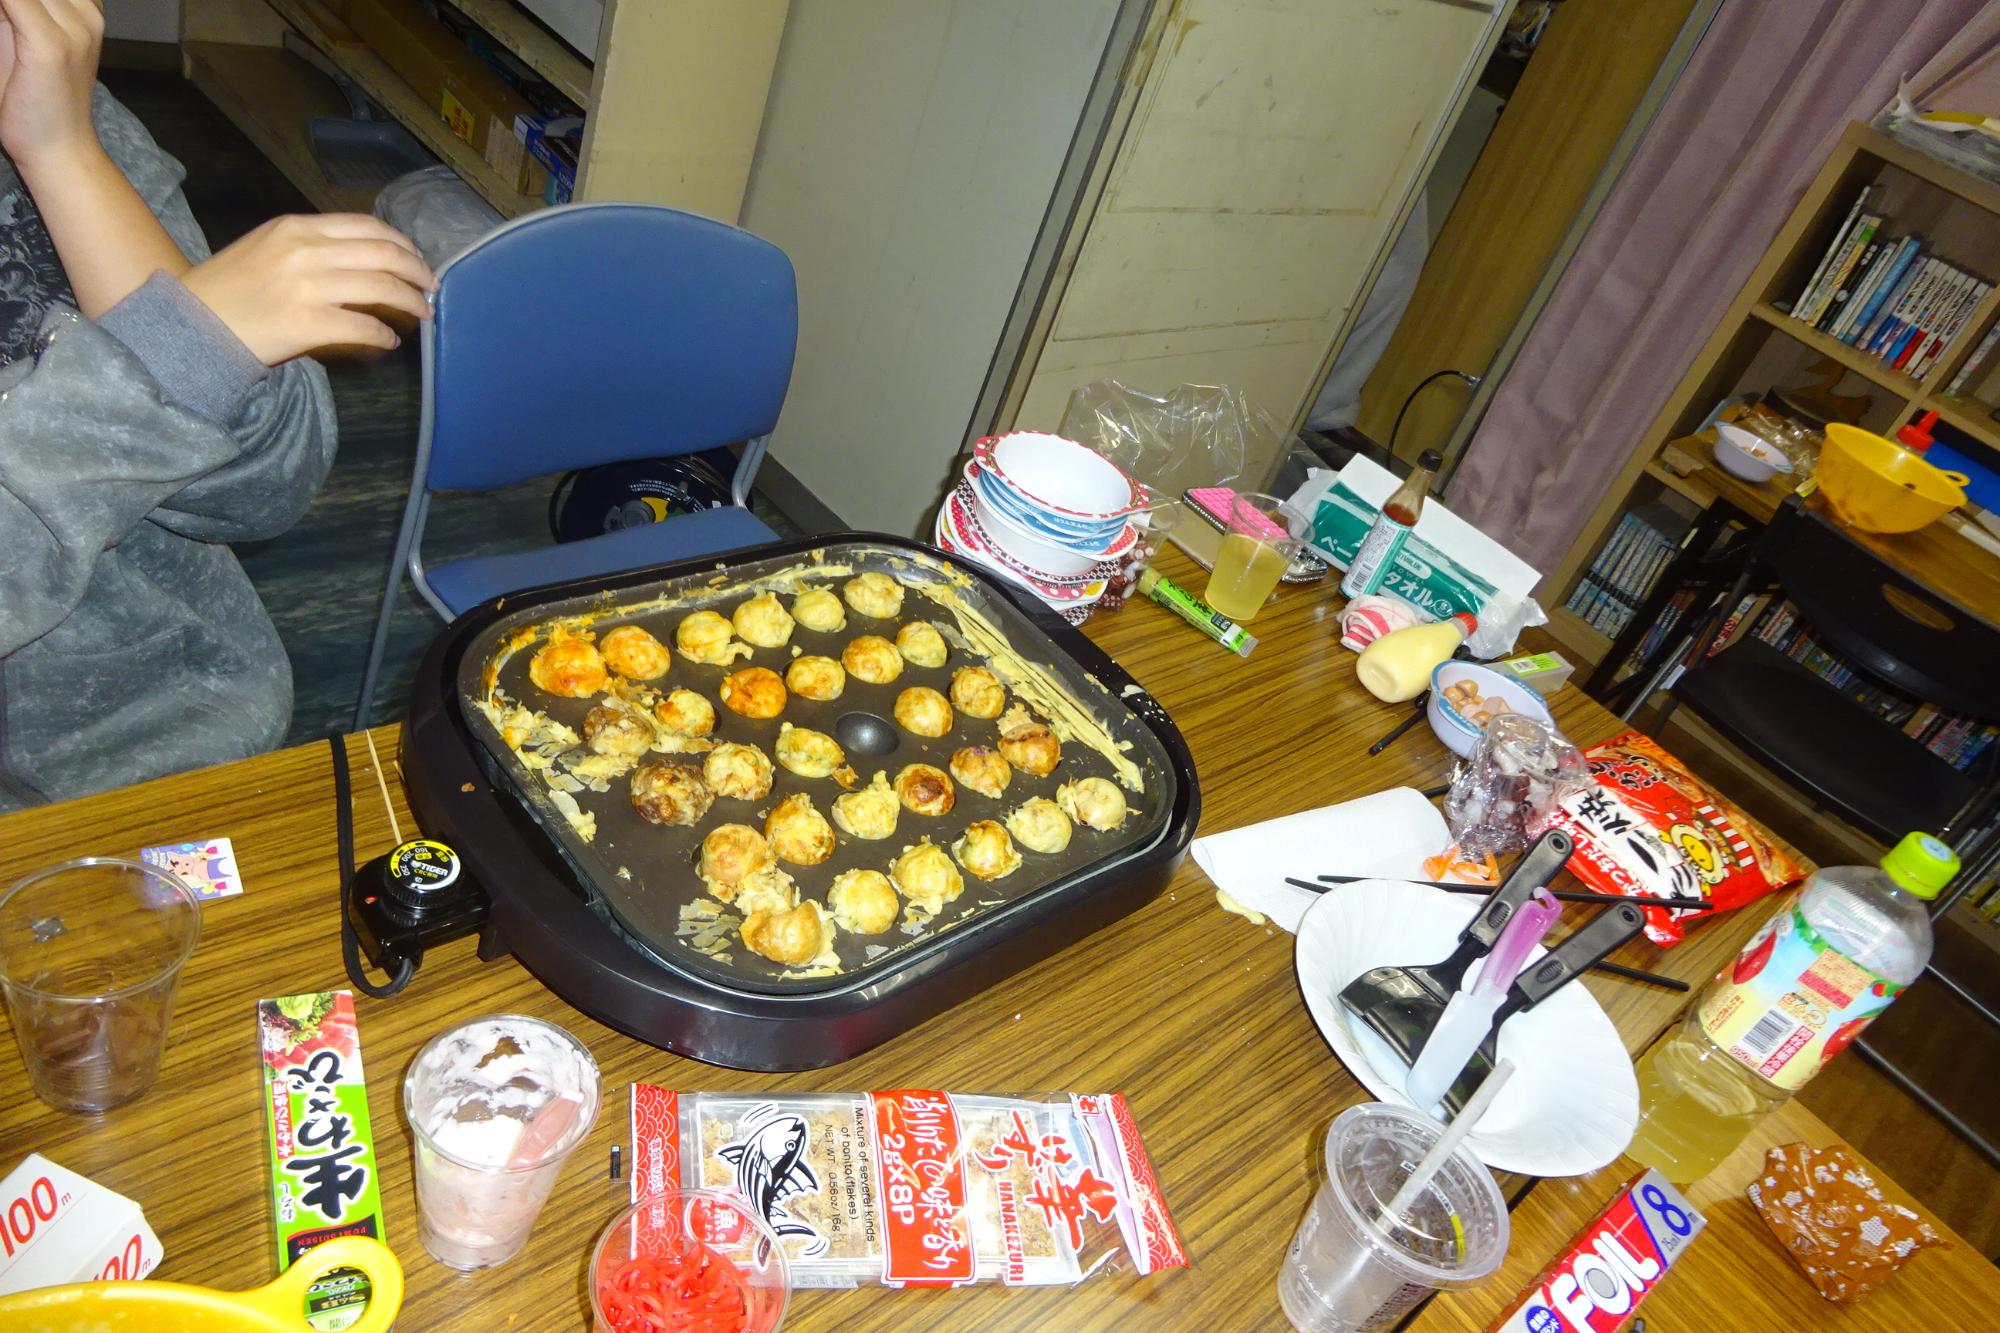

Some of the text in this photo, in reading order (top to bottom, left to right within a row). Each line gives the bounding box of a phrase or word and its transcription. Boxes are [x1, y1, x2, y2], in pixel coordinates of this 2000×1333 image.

[421, 862, 448, 877] TIGER
[286, 1051, 364, 1219] 生わさび
[825, 1124, 833, 1146] NET
[841, 1127, 848, 1140] of
[855, 1107, 875, 1242] Mixture of several kinds
[998, 1181, 1024, 1282] HANAKEZURI
[1550, 1230, 1660, 1333] FOIL
